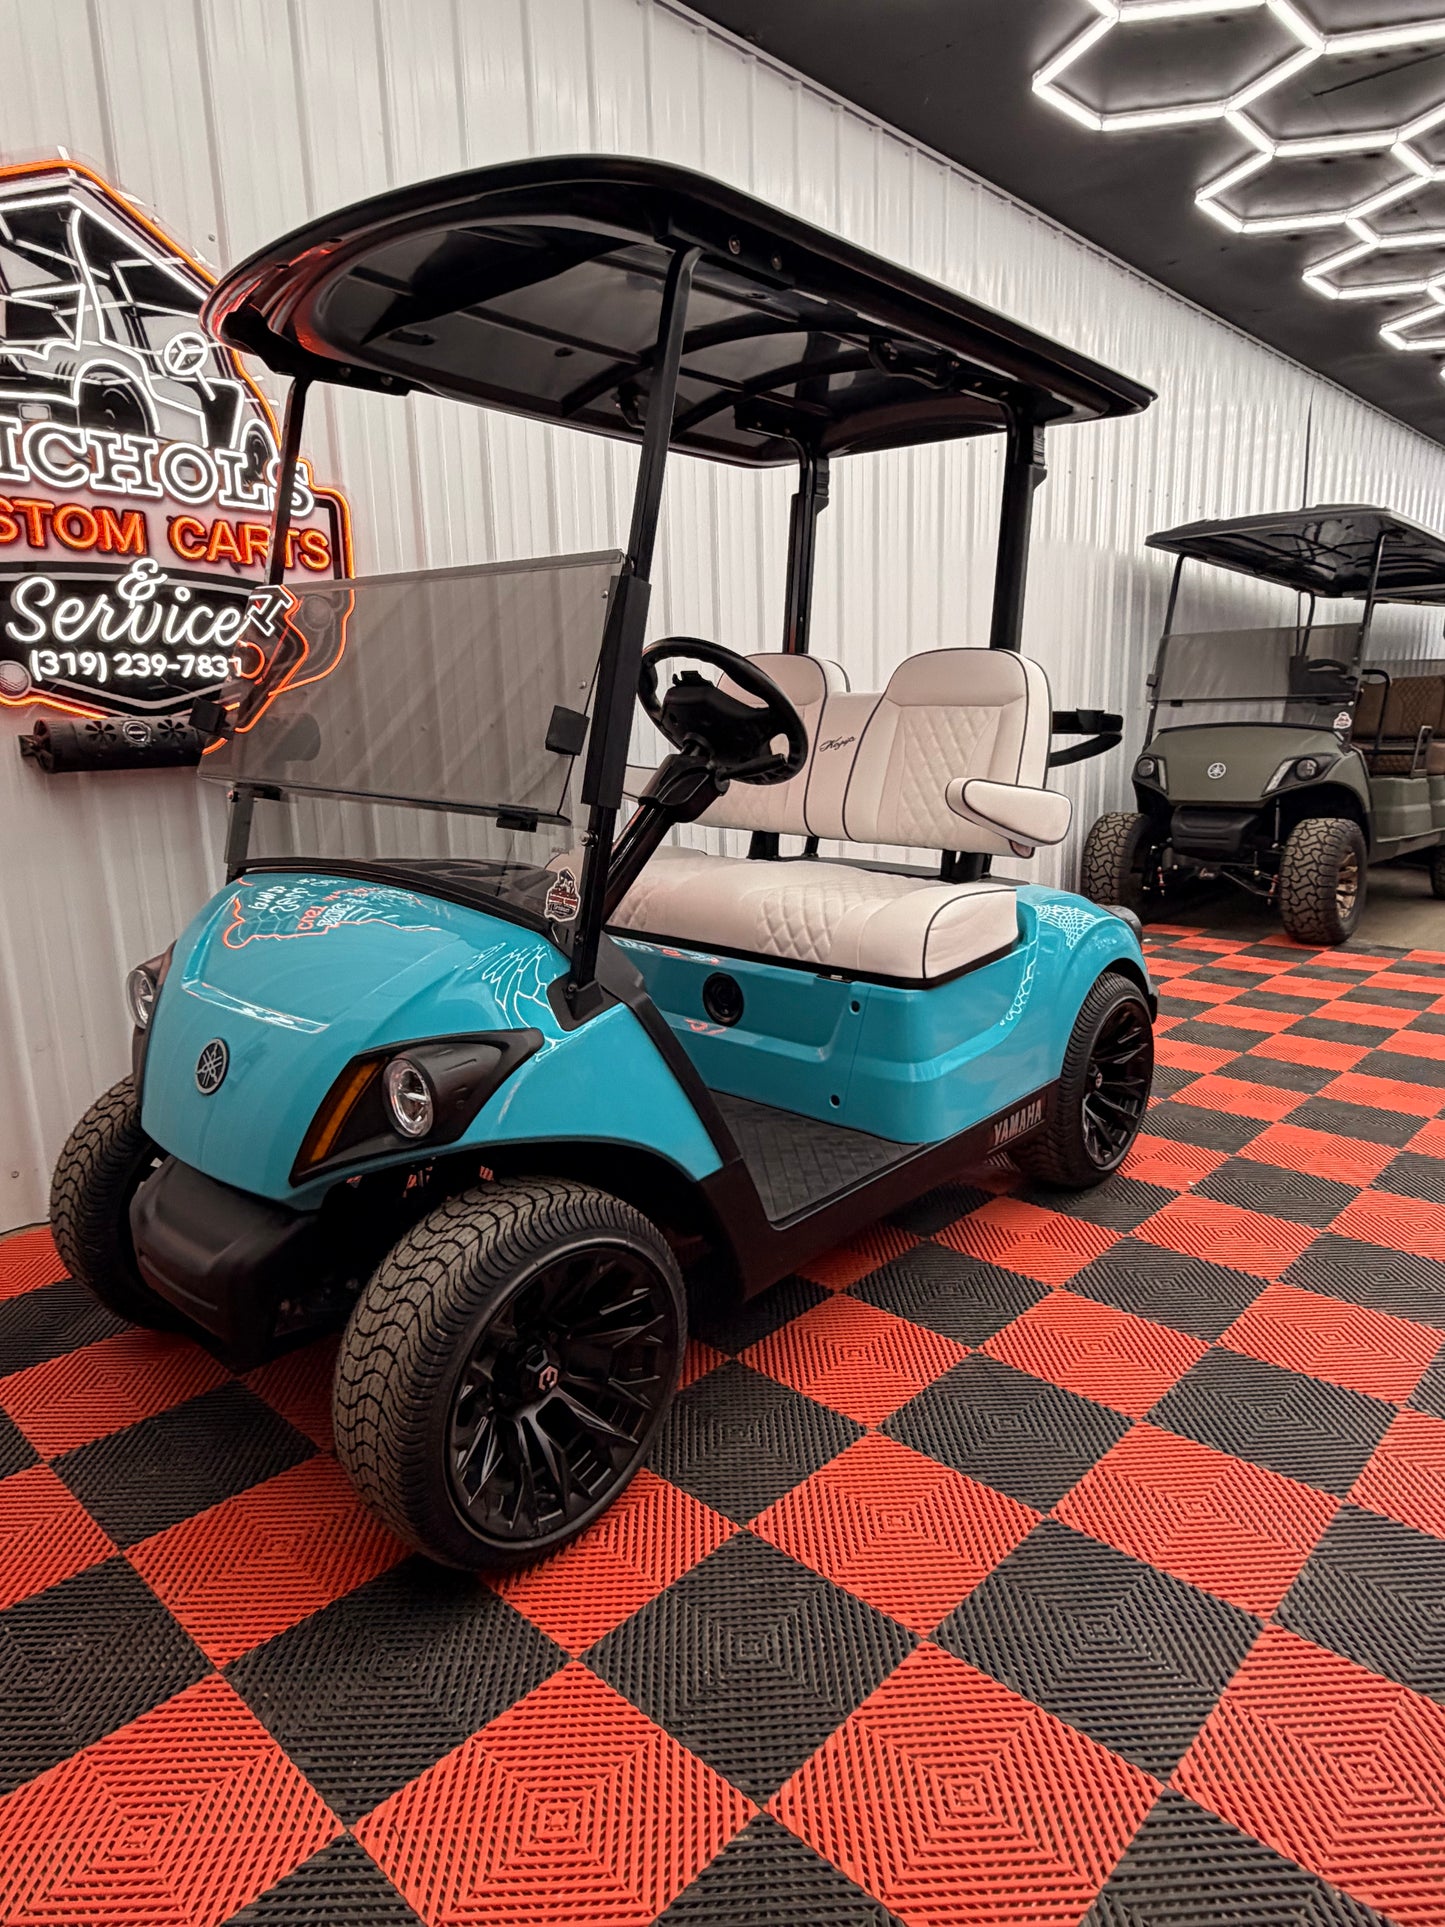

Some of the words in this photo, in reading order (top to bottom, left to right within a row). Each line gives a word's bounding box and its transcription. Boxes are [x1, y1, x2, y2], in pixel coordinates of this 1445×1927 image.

[168, 515, 331, 571] CARTS
[117, 557, 167, 609] &
[6, 576, 251, 648] Service
[31, 649, 107, 683] (319)
[114, 651, 242, 679] 239-7831
[993, 1099, 1043, 1147] YAMAHA
